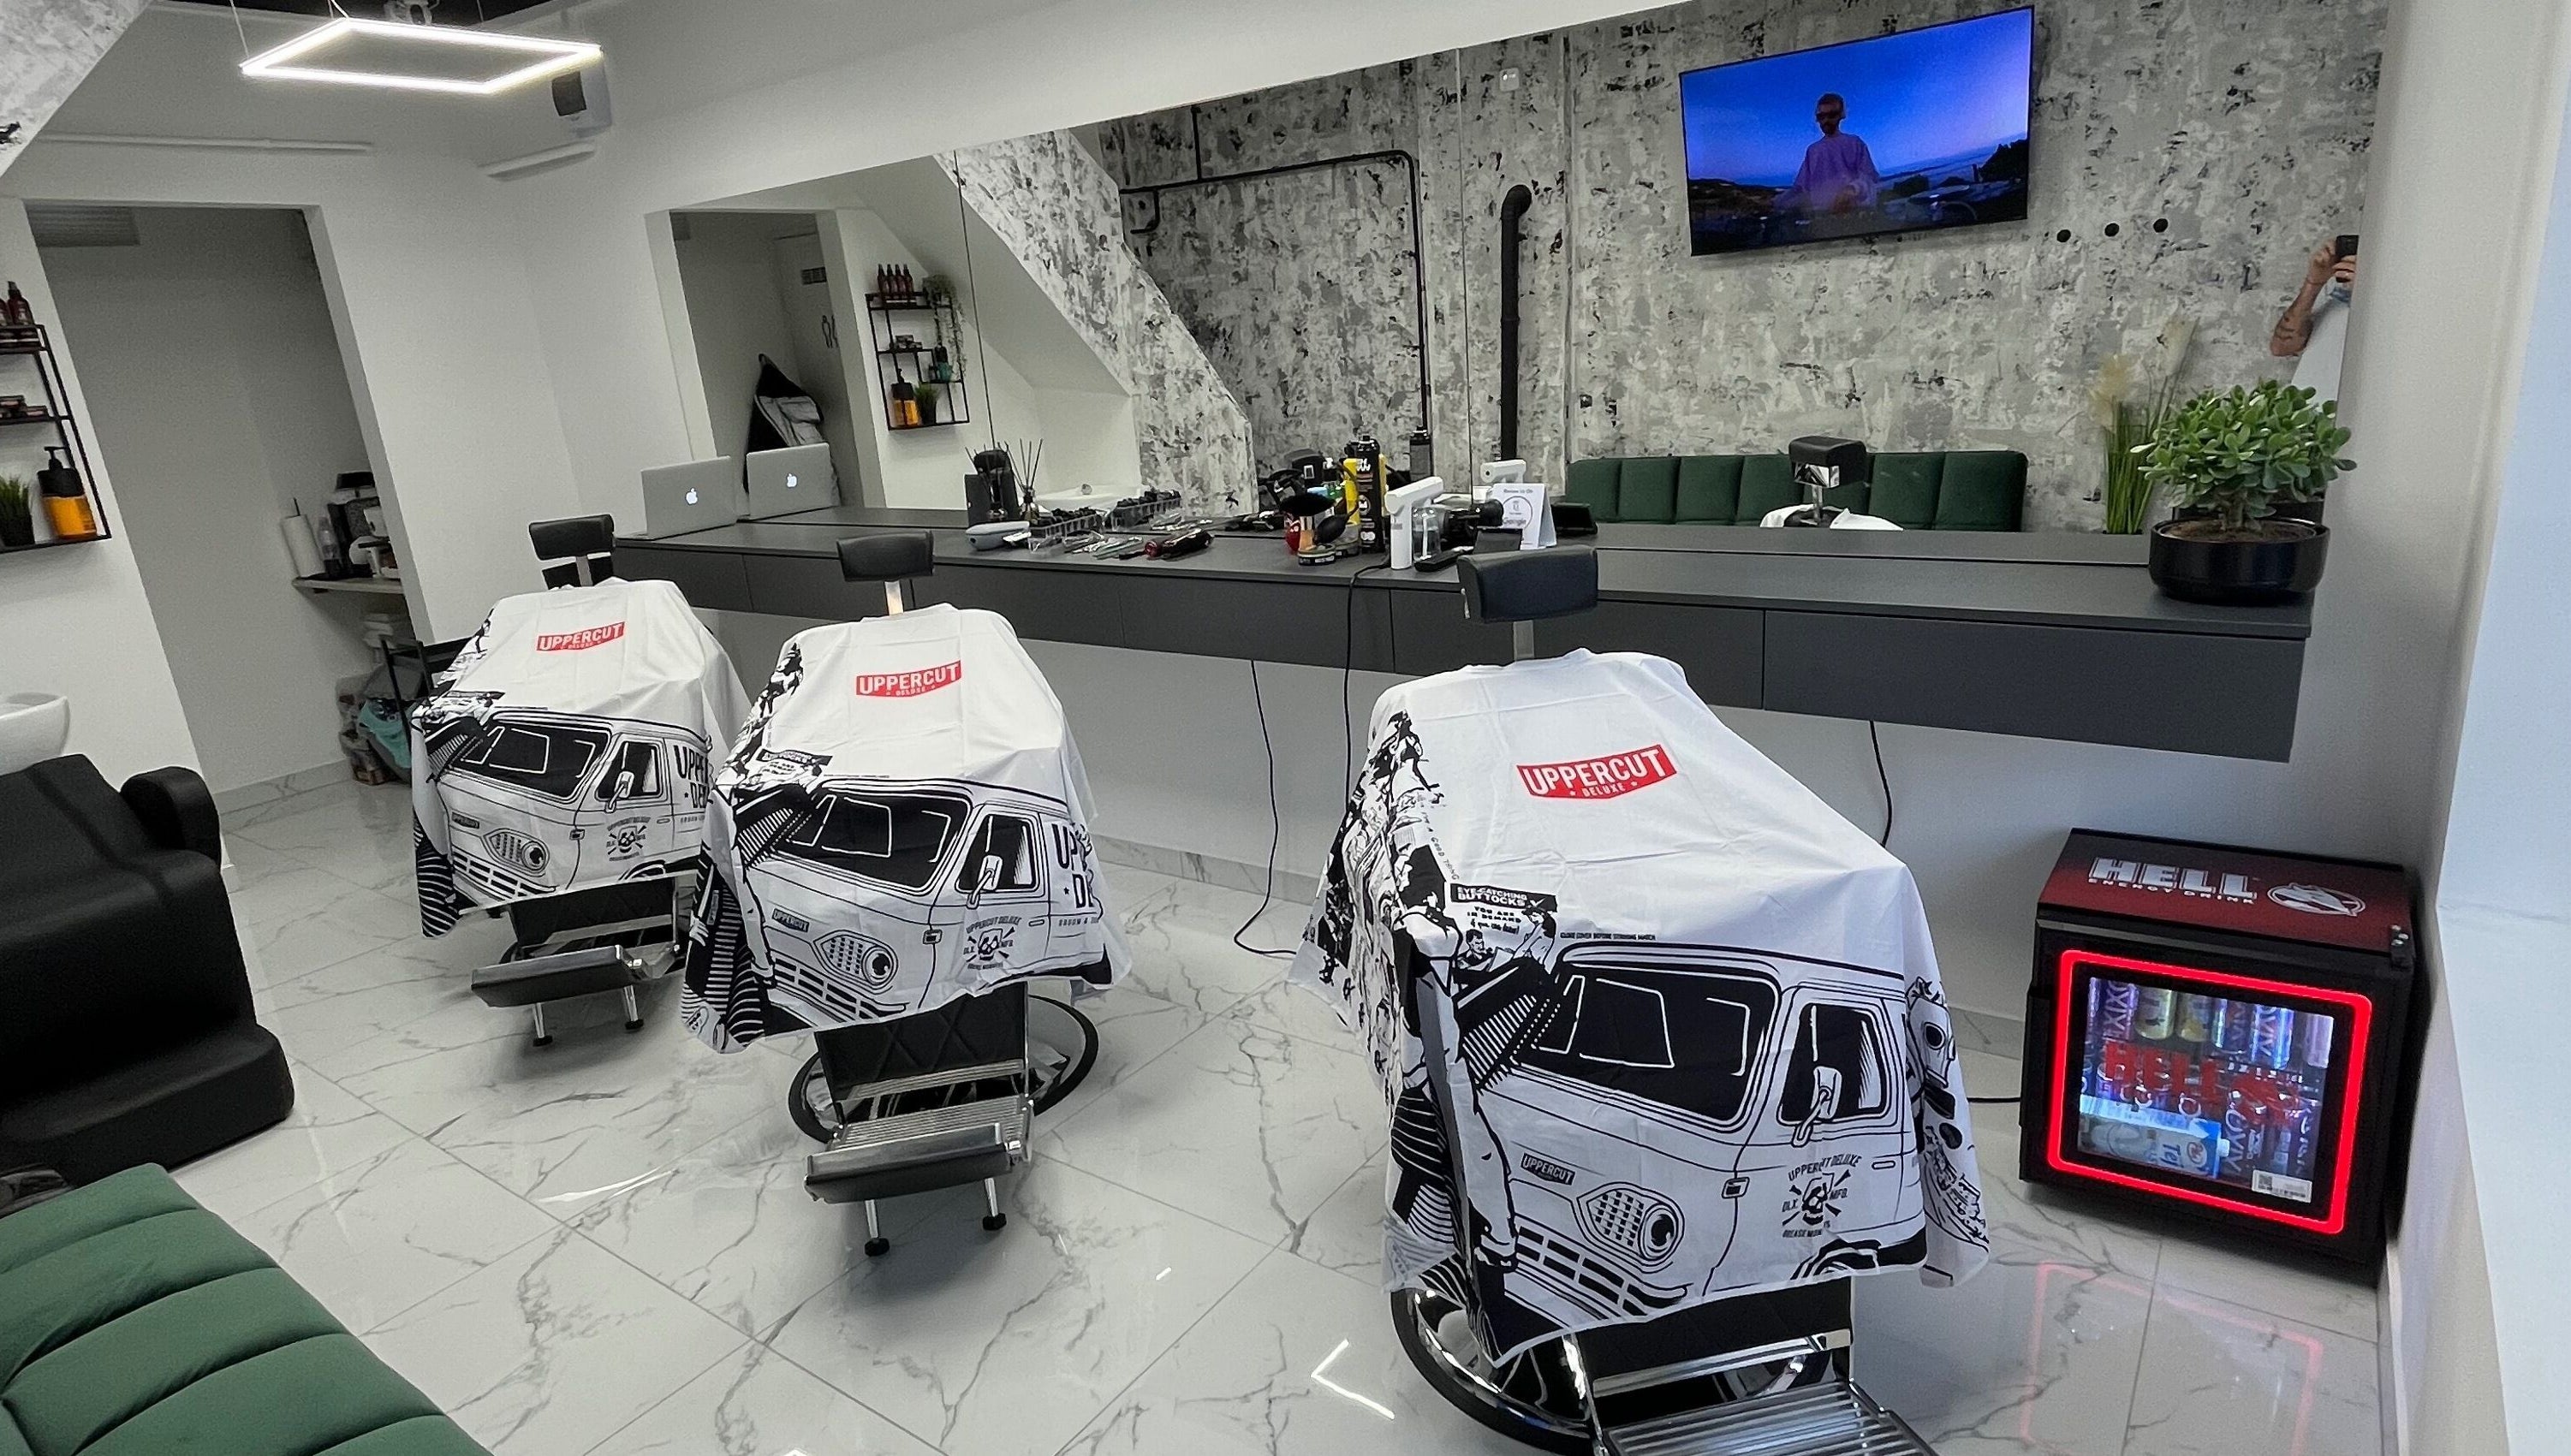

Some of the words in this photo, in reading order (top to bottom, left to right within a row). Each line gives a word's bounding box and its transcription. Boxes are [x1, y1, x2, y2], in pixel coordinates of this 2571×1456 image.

[539, 623, 623, 651] UPPERCUT
[859, 663, 958, 694] UPPERCUT
[1522, 749, 1666, 794] UPPERCUT
[1582, 782, 1626, 797] DELUXE
[2088, 857, 2257, 899] HELL
[2088, 878, 2173, 893] ENERGY
[2183, 890, 2254, 904] DRINK
[1458, 893, 1526, 906] BUTTOCKS
[1523, 1156, 1574, 1183] UPPERCUT
